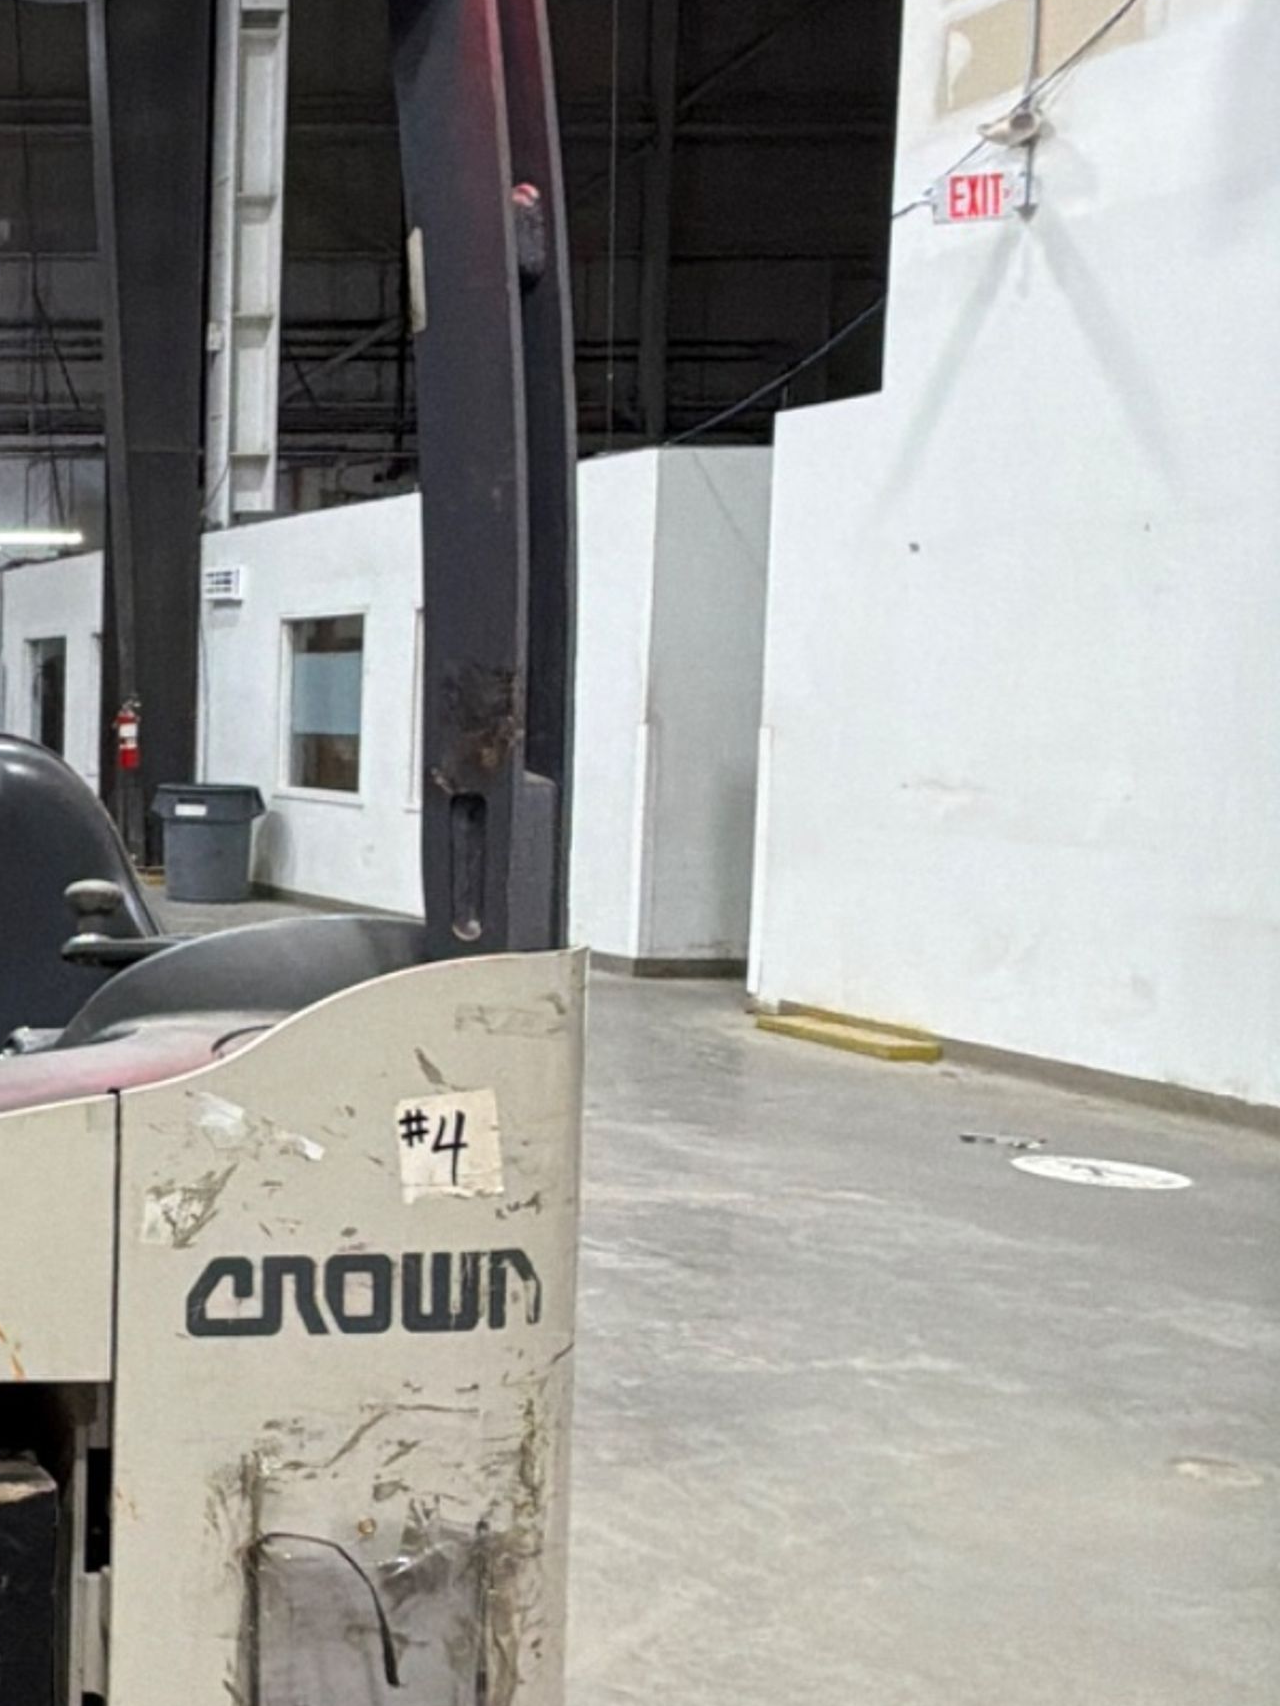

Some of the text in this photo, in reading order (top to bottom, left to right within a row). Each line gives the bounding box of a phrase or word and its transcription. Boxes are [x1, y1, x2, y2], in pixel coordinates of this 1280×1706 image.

[949, 173, 1003, 219] EXIT
[399, 1109, 468, 1186] #4
[186, 1249, 541, 1337] CROWN
